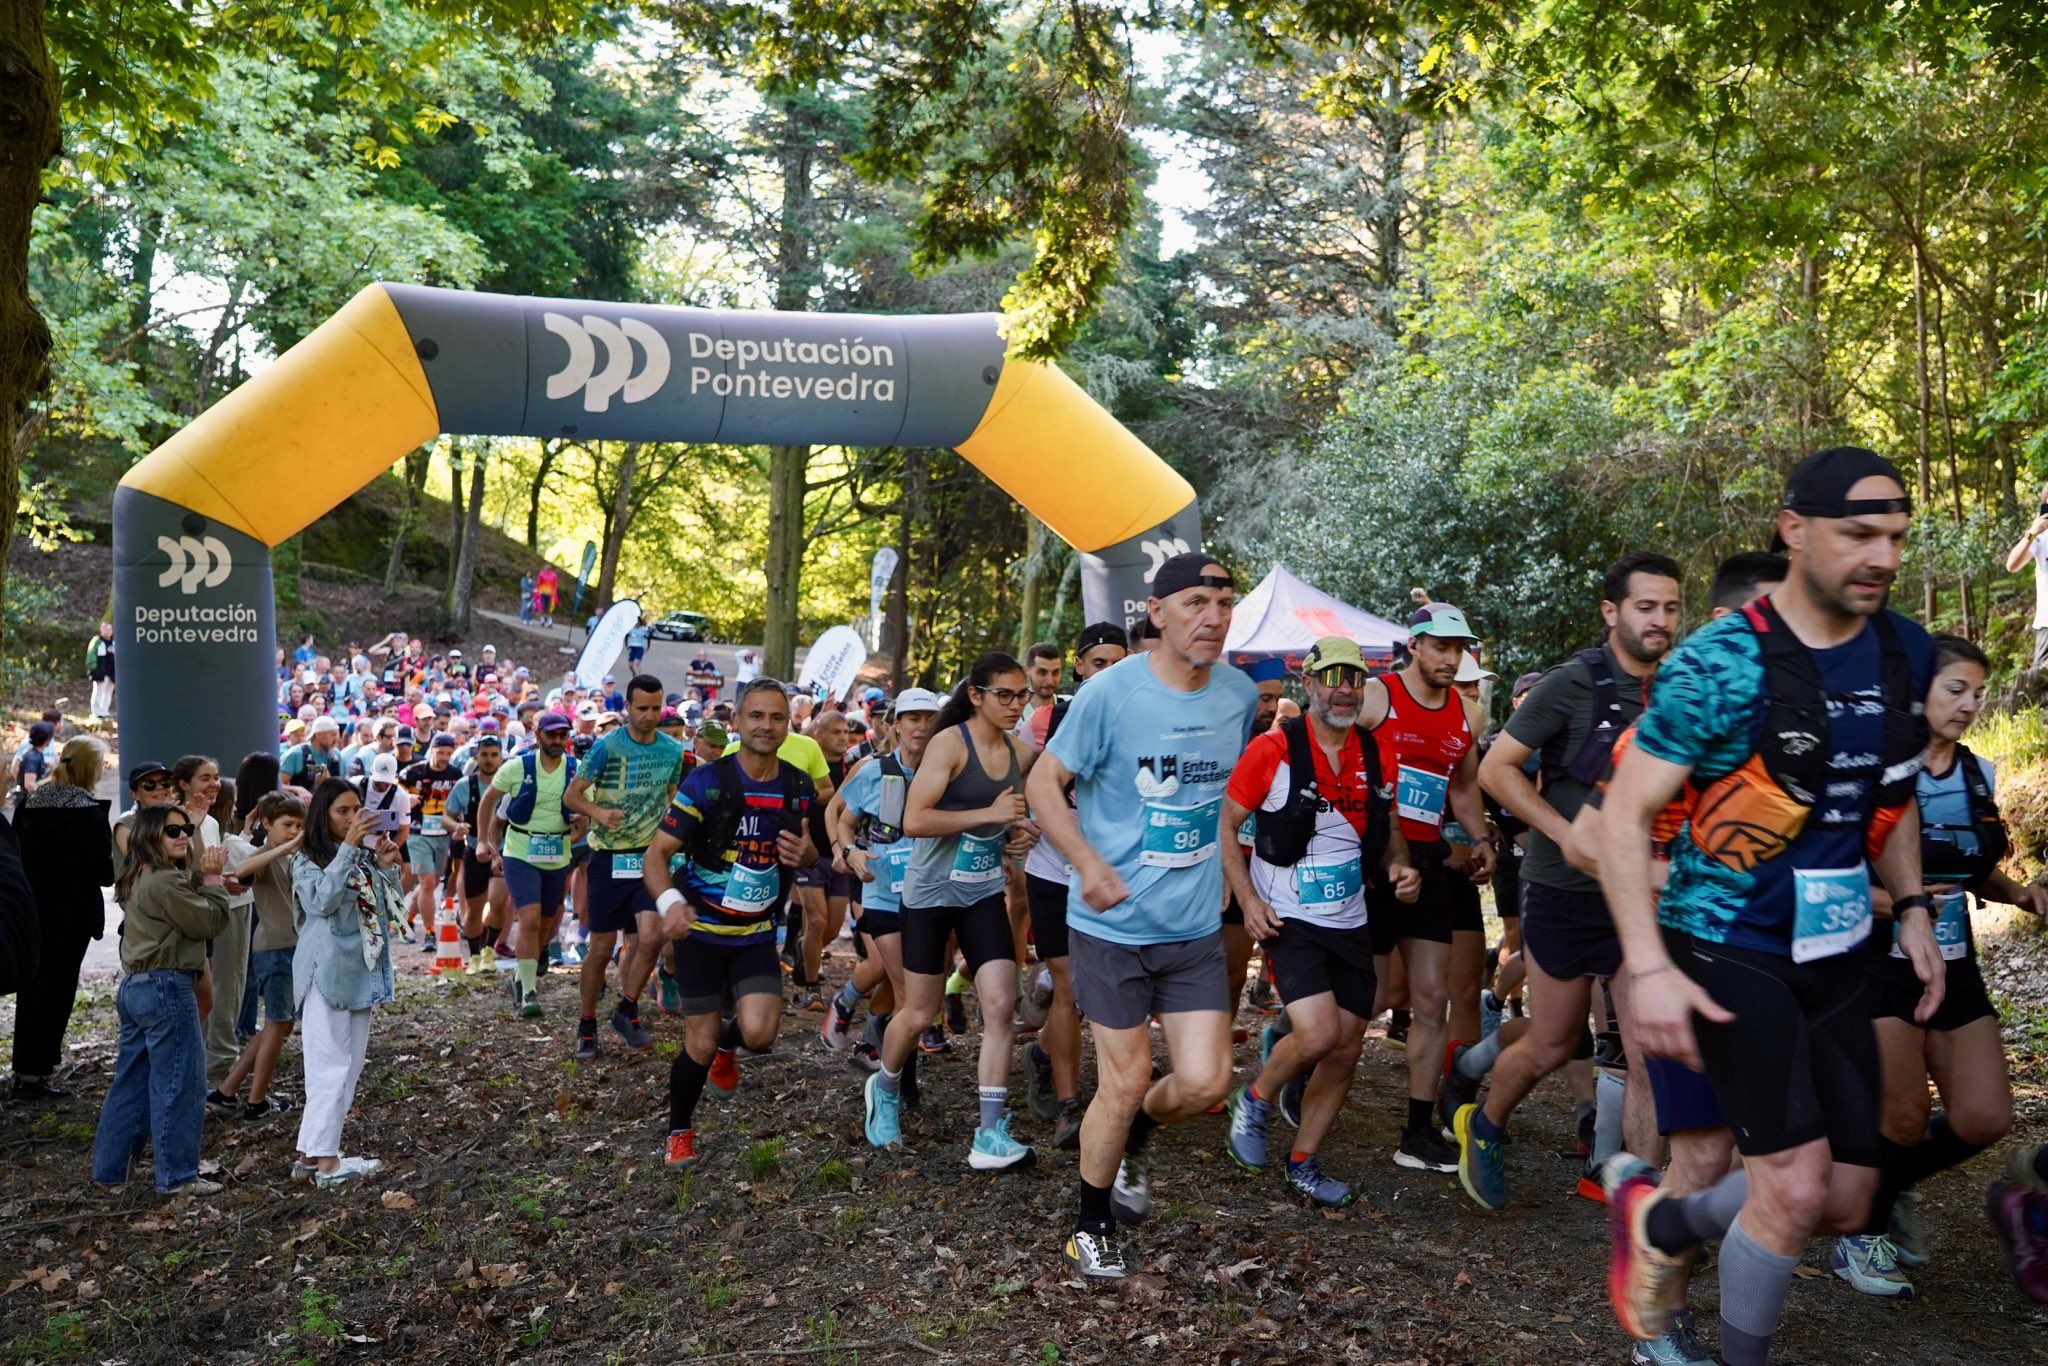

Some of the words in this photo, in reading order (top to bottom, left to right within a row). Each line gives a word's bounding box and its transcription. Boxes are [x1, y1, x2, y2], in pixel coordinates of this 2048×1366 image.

[689, 332, 894, 371] Deputación
[690, 367, 895, 402] Pontevedra
[135, 603, 257, 627] Deputación
[135, 625, 258, 643] Pontevedra
[637, 771, 652, 780] DO
[1182, 760, 1218, 773] Entre
[1407, 788, 1429, 807] 117
[1173, 828, 1201, 850] 98
[970, 853, 996, 870] 385
[741, 885, 771, 900] 328
[1323, 881, 1346, 899] 65
